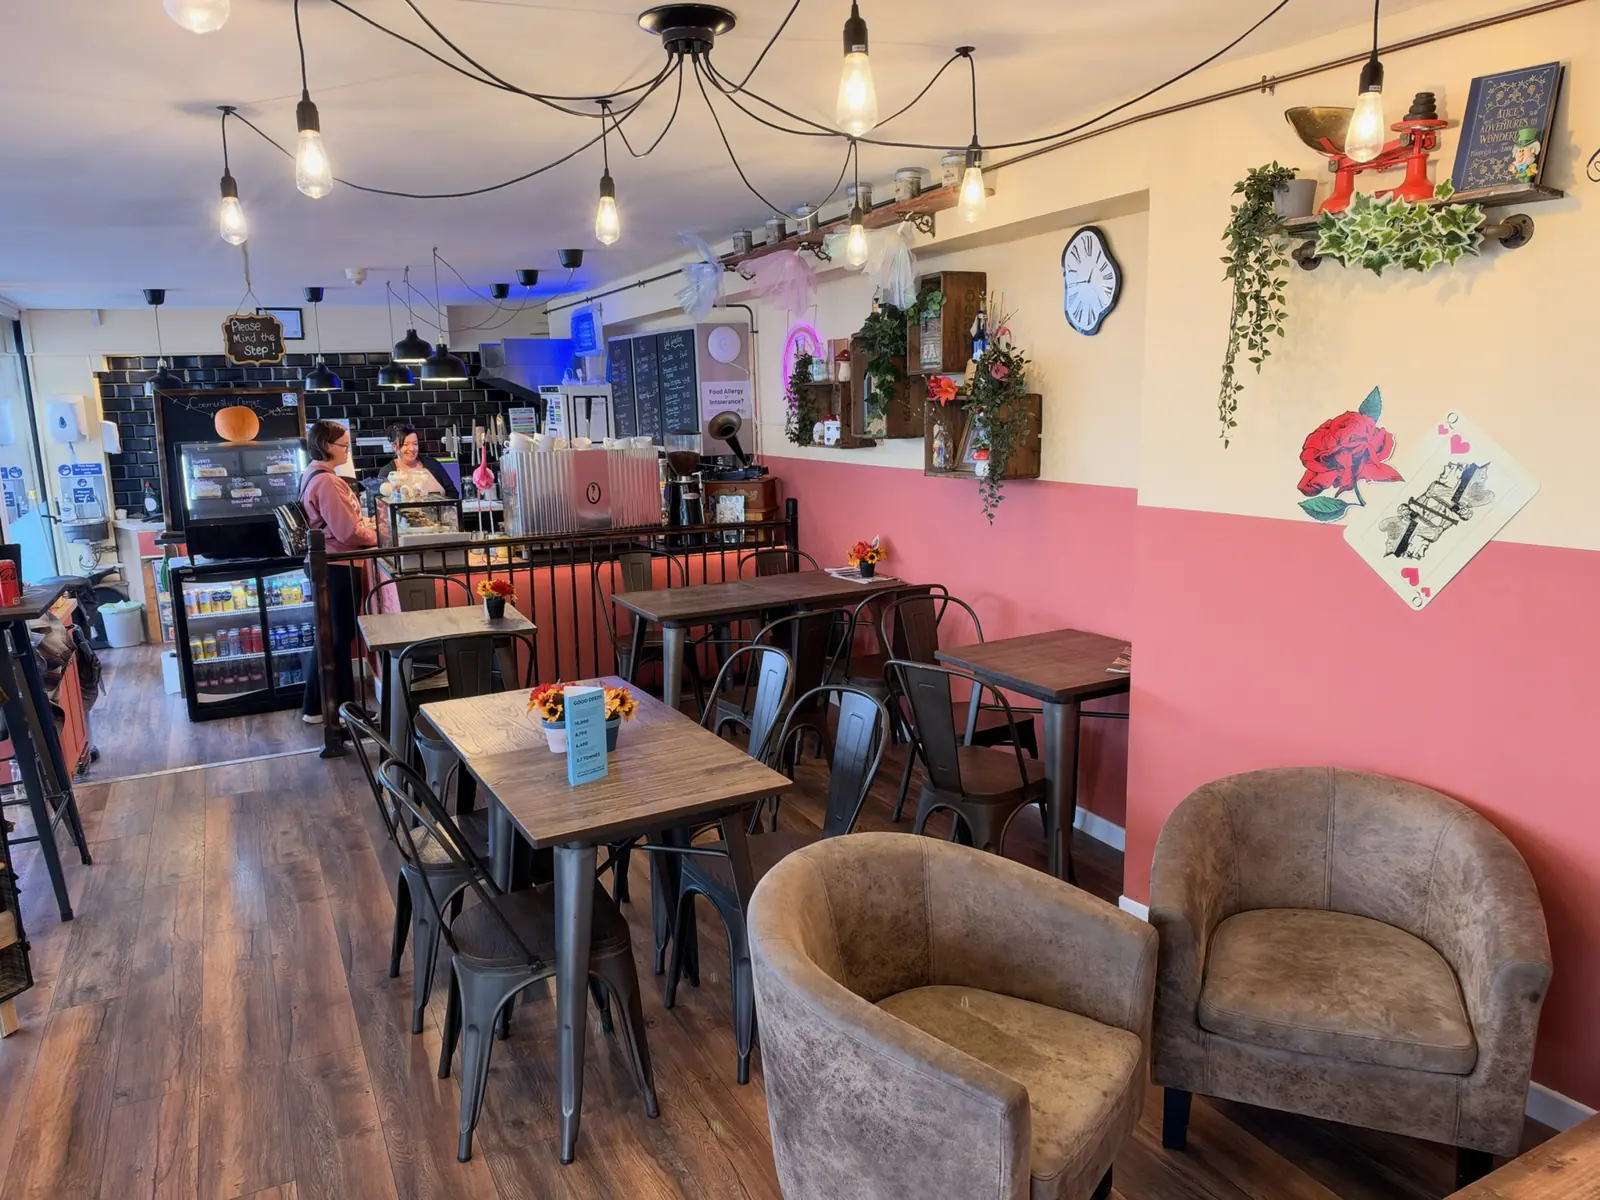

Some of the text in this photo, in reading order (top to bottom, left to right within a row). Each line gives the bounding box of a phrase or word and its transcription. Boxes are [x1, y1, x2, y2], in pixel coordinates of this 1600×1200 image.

[1480, 117, 1528, 134] ADVENTURES
[1480, 130, 1520, 144] WONDERL
[231, 319, 261, 333] Please
[233, 332, 276, 343] Mind the
[723, 388, 744, 396] Allergy
[573, 694, 603, 706] GOOD DEEDS
[583, 752, 601, 761] TONNES
